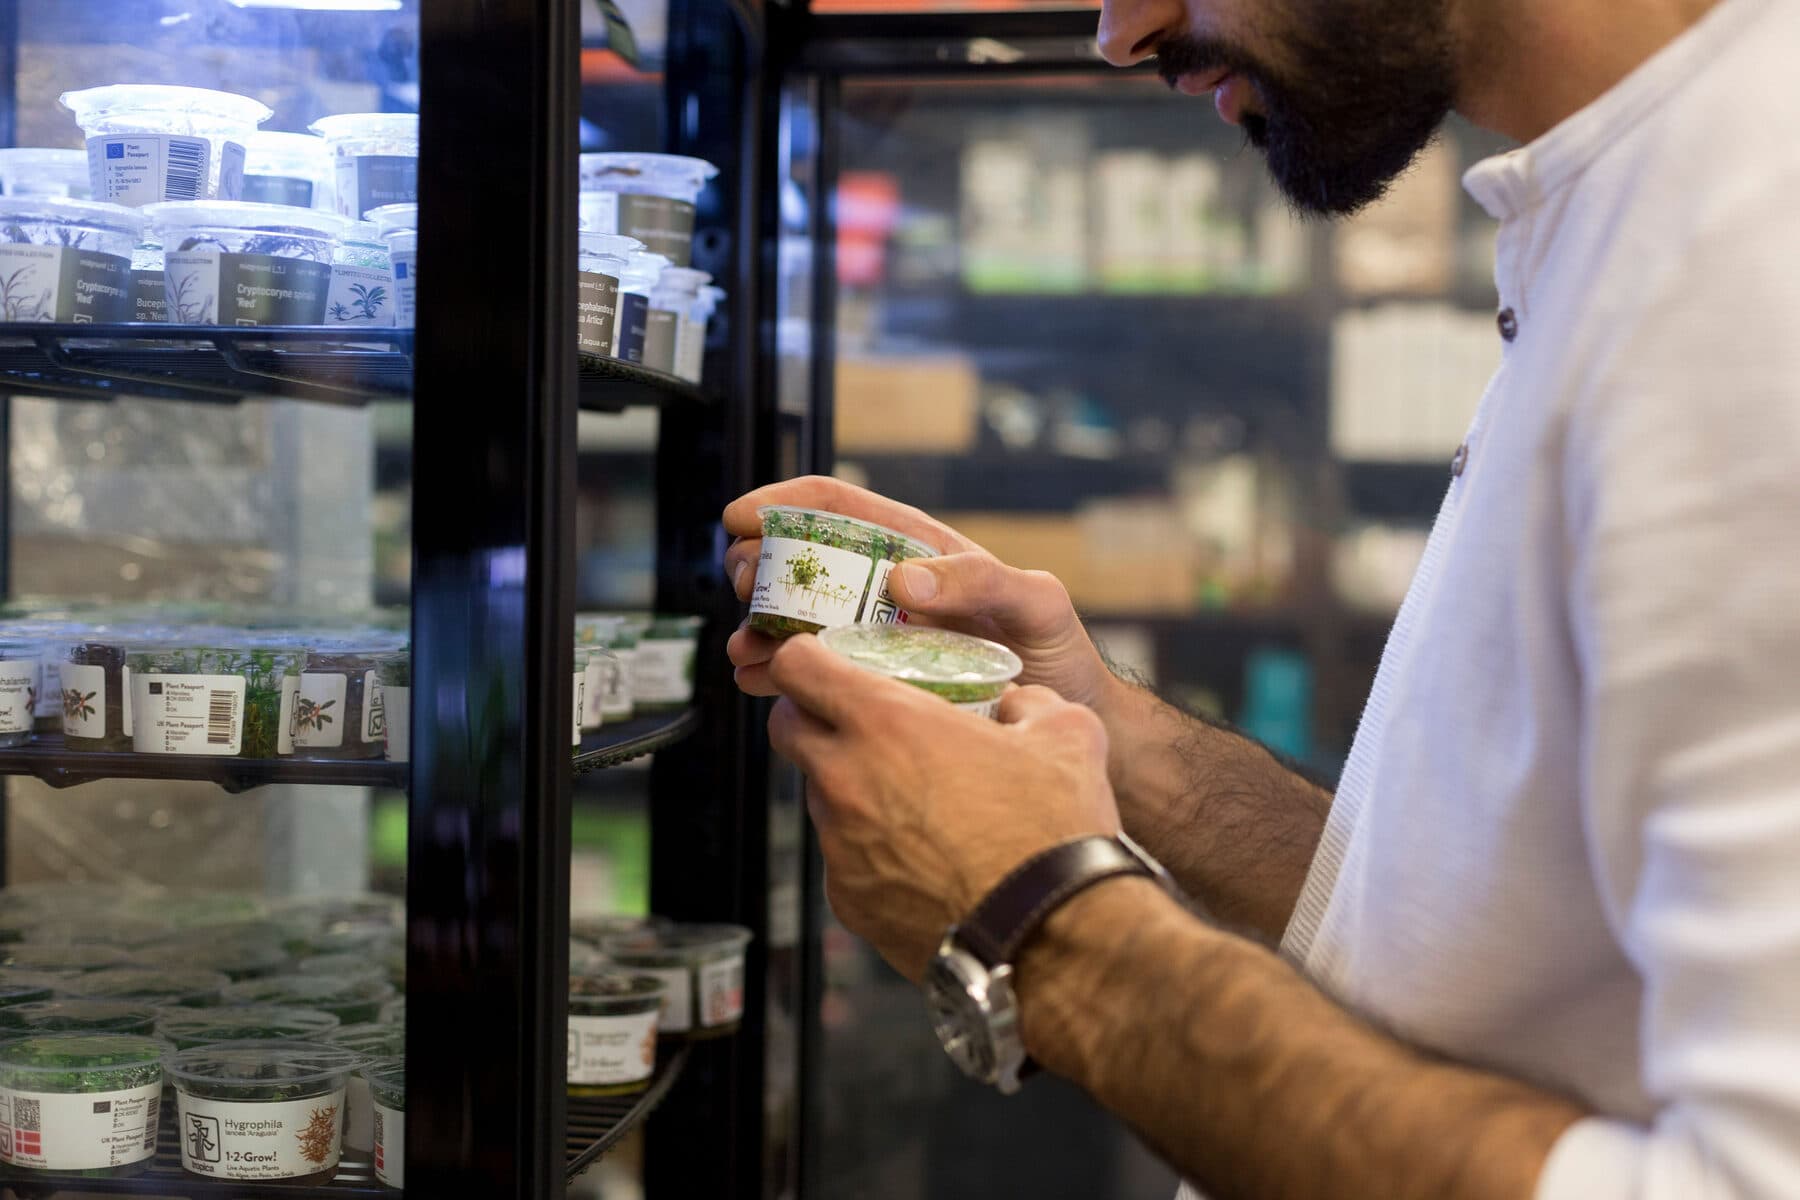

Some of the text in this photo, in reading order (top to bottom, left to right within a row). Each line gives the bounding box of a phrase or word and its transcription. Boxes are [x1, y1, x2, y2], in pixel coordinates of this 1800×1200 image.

[237, 283, 292, 299] Cryptocoryne
[136, 297, 168, 311] Buceph
[181, 683, 205, 691] Passport
[180, 722, 204, 731] Passport
[225, 1119, 283, 1131] Hygrophila
[191, 1161, 215, 1173] tropica
[239, 1165, 260, 1173] Aquatic
